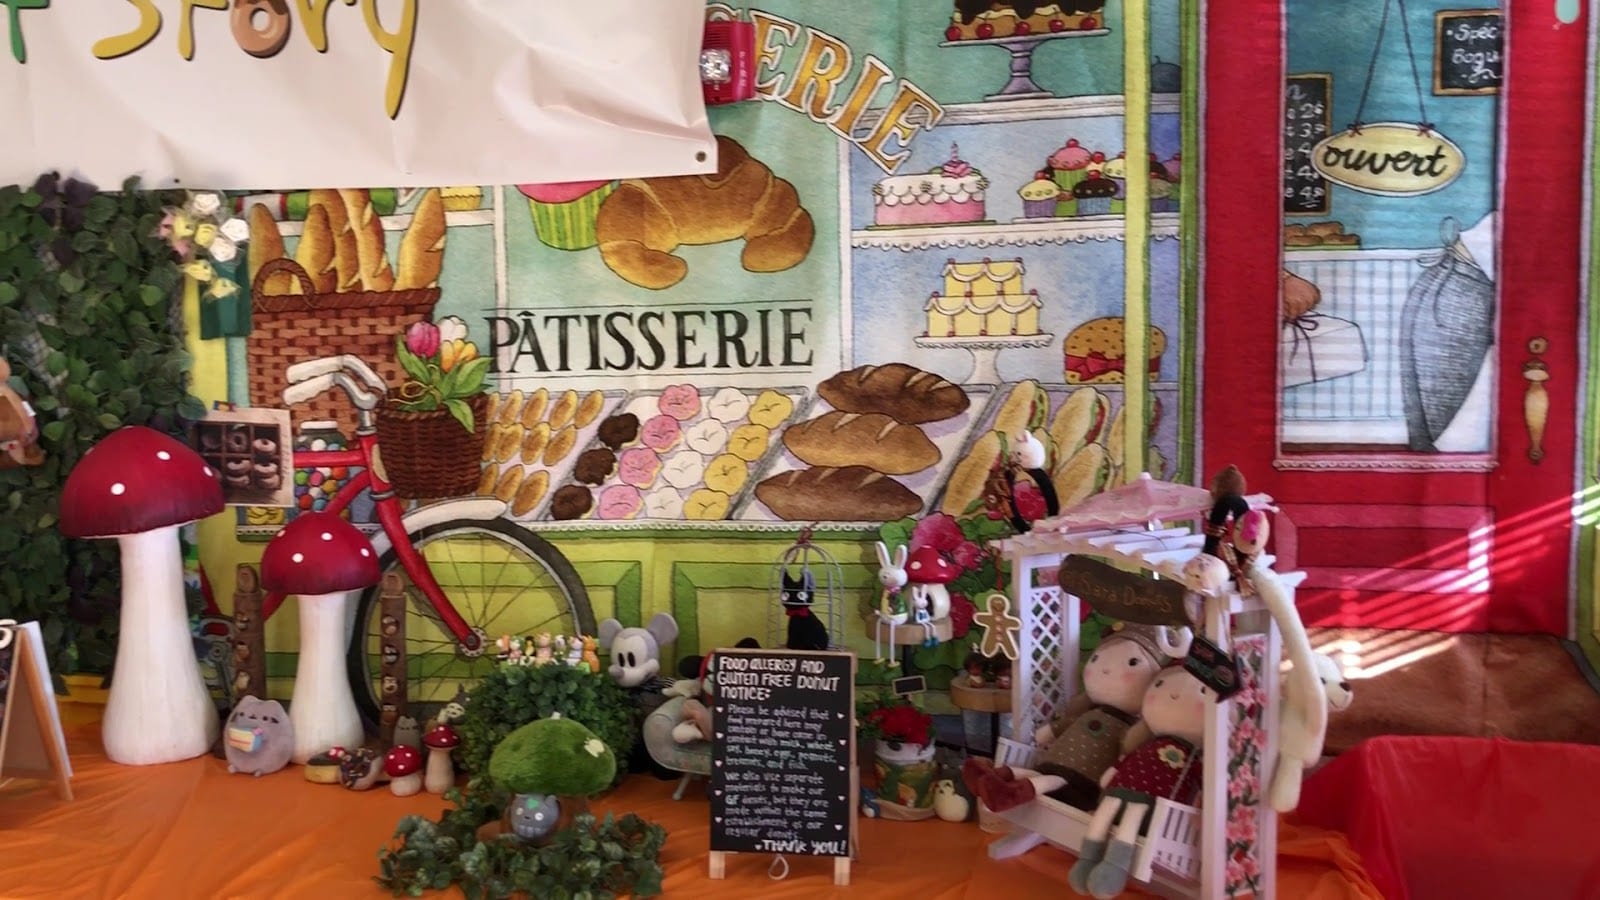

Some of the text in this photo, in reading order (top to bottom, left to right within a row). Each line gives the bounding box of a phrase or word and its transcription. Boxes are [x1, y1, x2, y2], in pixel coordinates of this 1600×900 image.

[1323, 144, 1448, 178] ouvert
[484, 306, 814, 375] PÂTISSERIE
[720, 656, 748, 671] FOOD
[761, 673, 793, 687] FREE
[811, 840, 847, 855] YOU!
